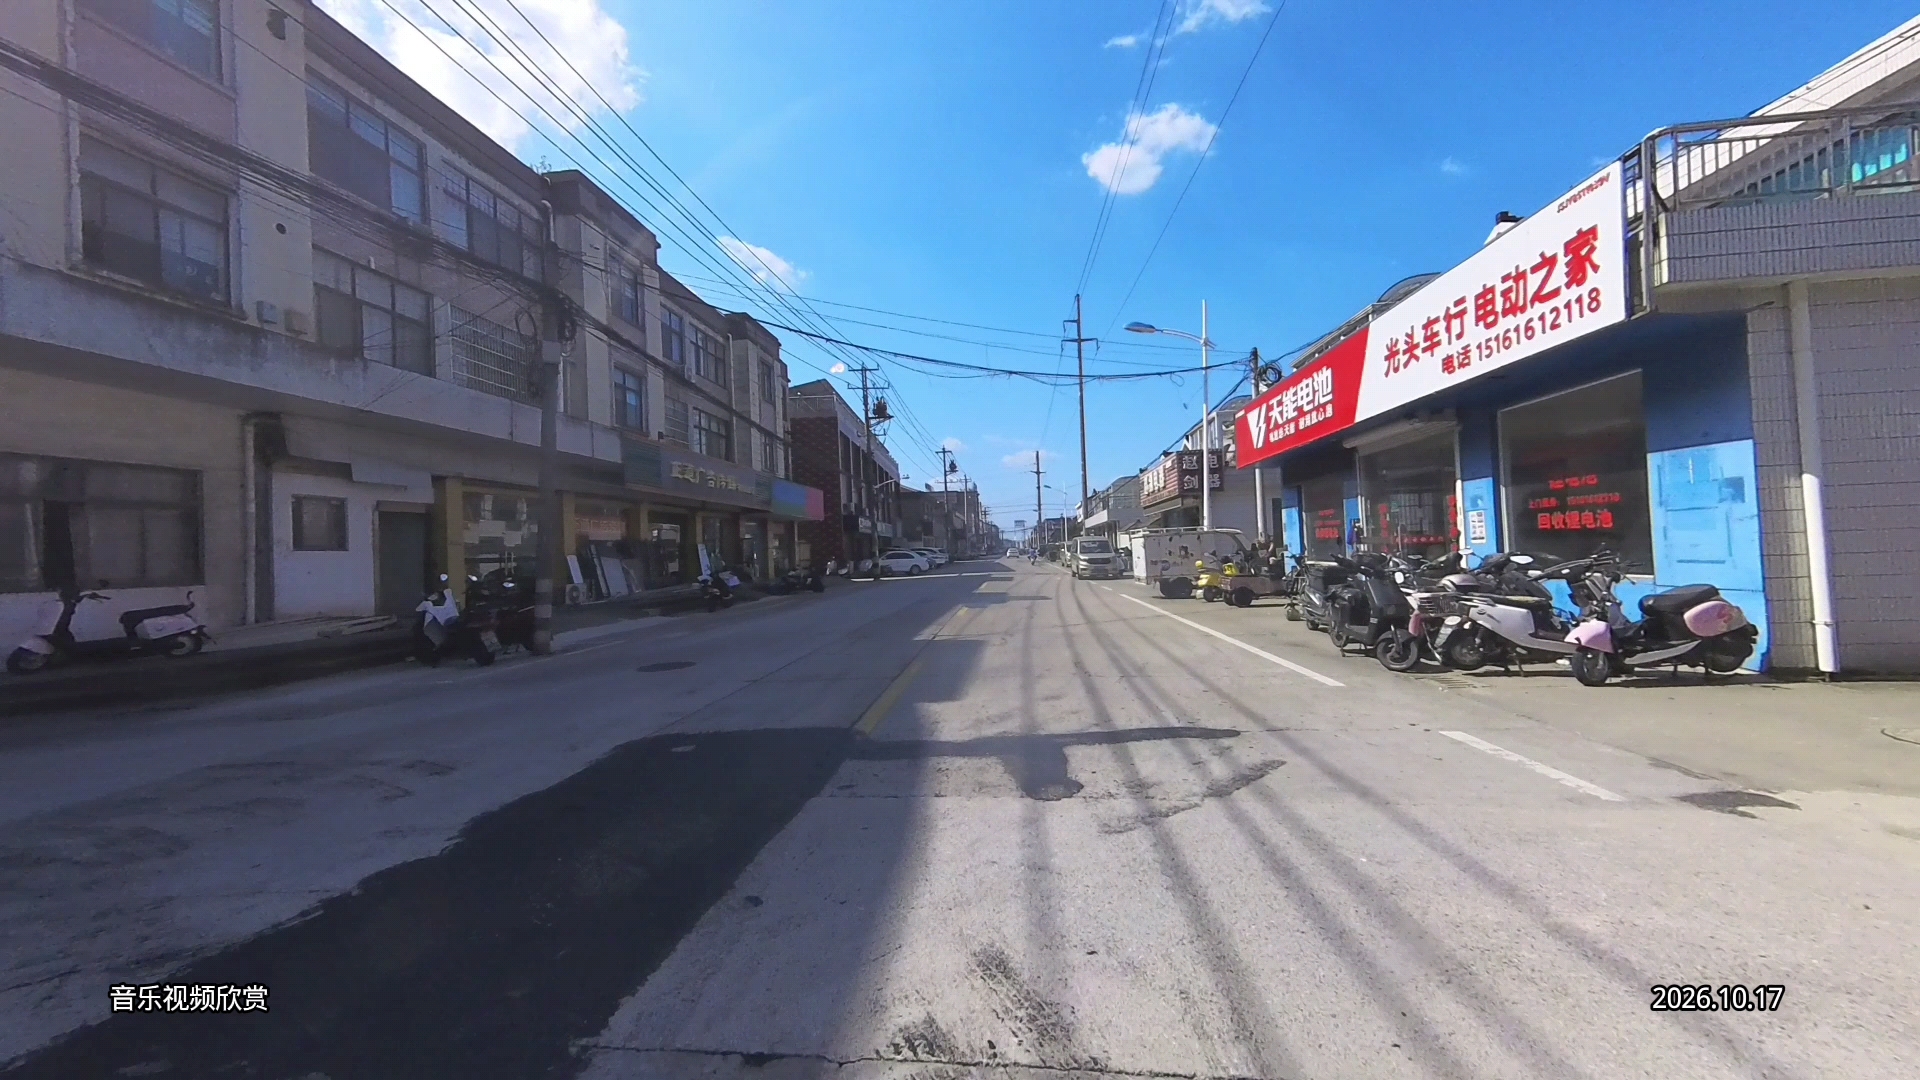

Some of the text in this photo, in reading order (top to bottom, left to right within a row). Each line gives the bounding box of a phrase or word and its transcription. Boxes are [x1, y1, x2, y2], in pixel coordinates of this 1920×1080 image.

[1384, 223, 1600, 378] 光头车行 电动之家
[1441, 287, 1602, 374] 电话 15161612118
[1268, 365, 1333, 429] 天能电池
